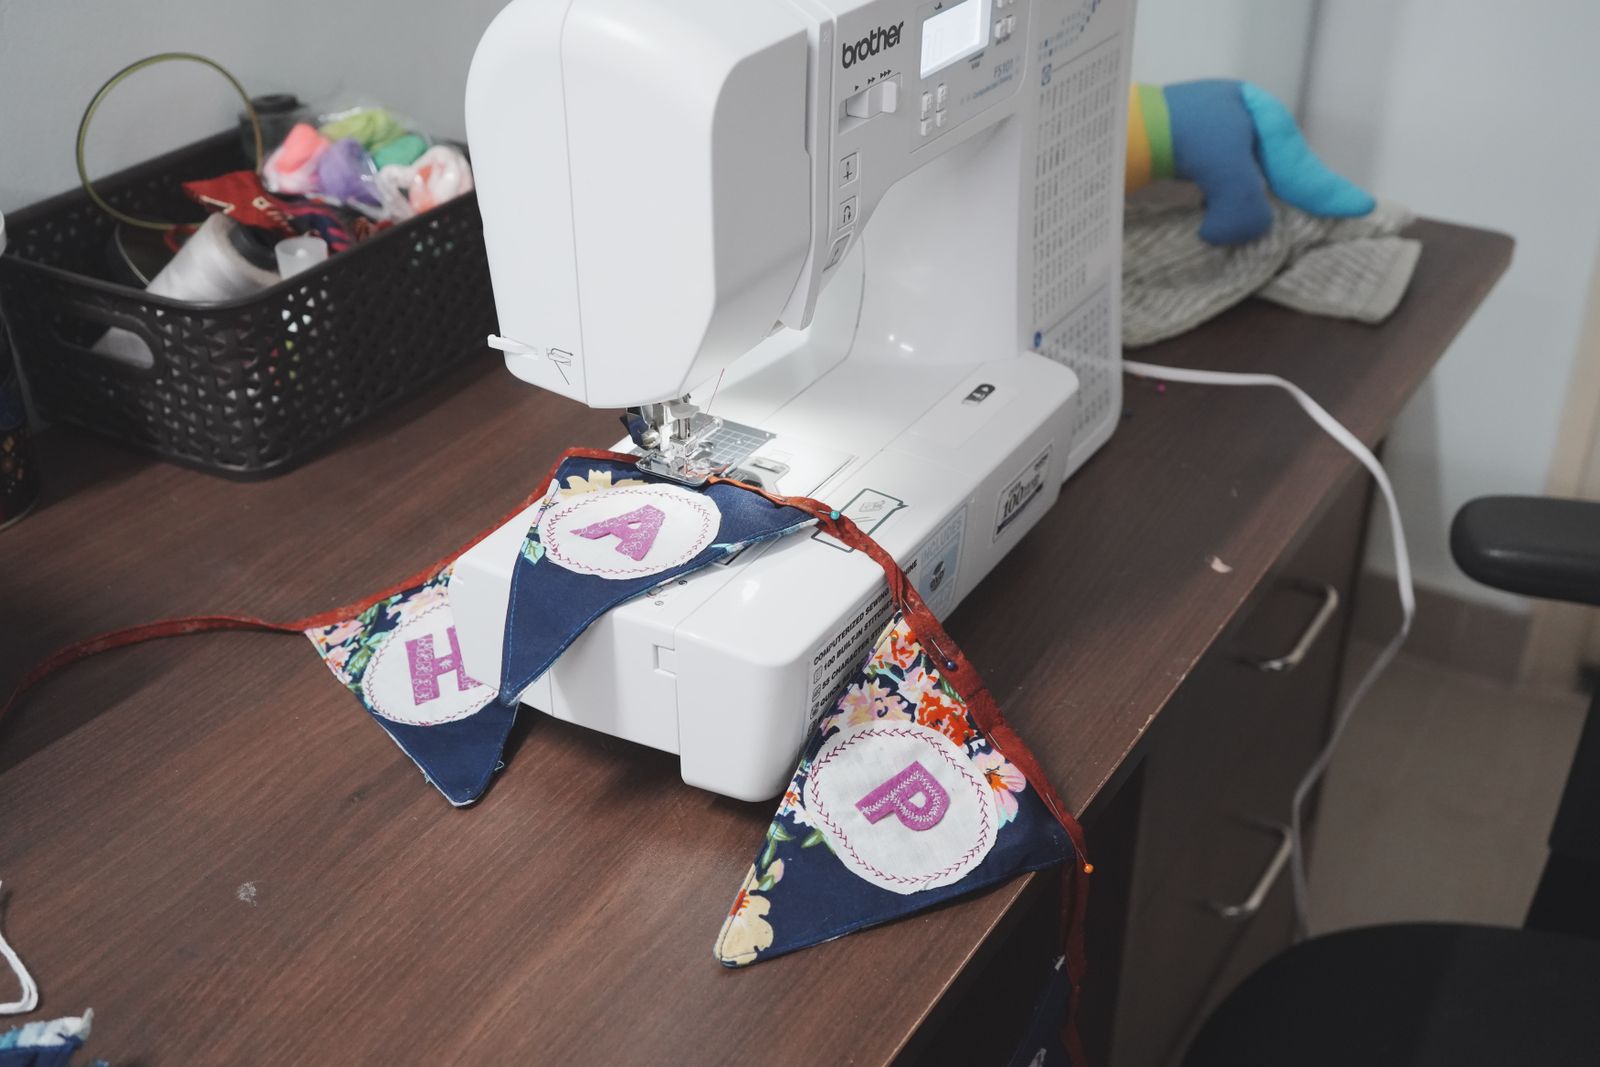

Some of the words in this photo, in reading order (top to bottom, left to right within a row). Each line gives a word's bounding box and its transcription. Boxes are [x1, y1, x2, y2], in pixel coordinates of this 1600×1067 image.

[842, 21, 904, 69] brother
[570, 504, 666, 561] A
[405, 625, 483, 706] H
[813, 611, 865, 666] COMPUTERIZED
[823, 655, 836, 670] 100
[836, 627, 864, 659] BUILT-IN
[855, 760, 950, 832] P
